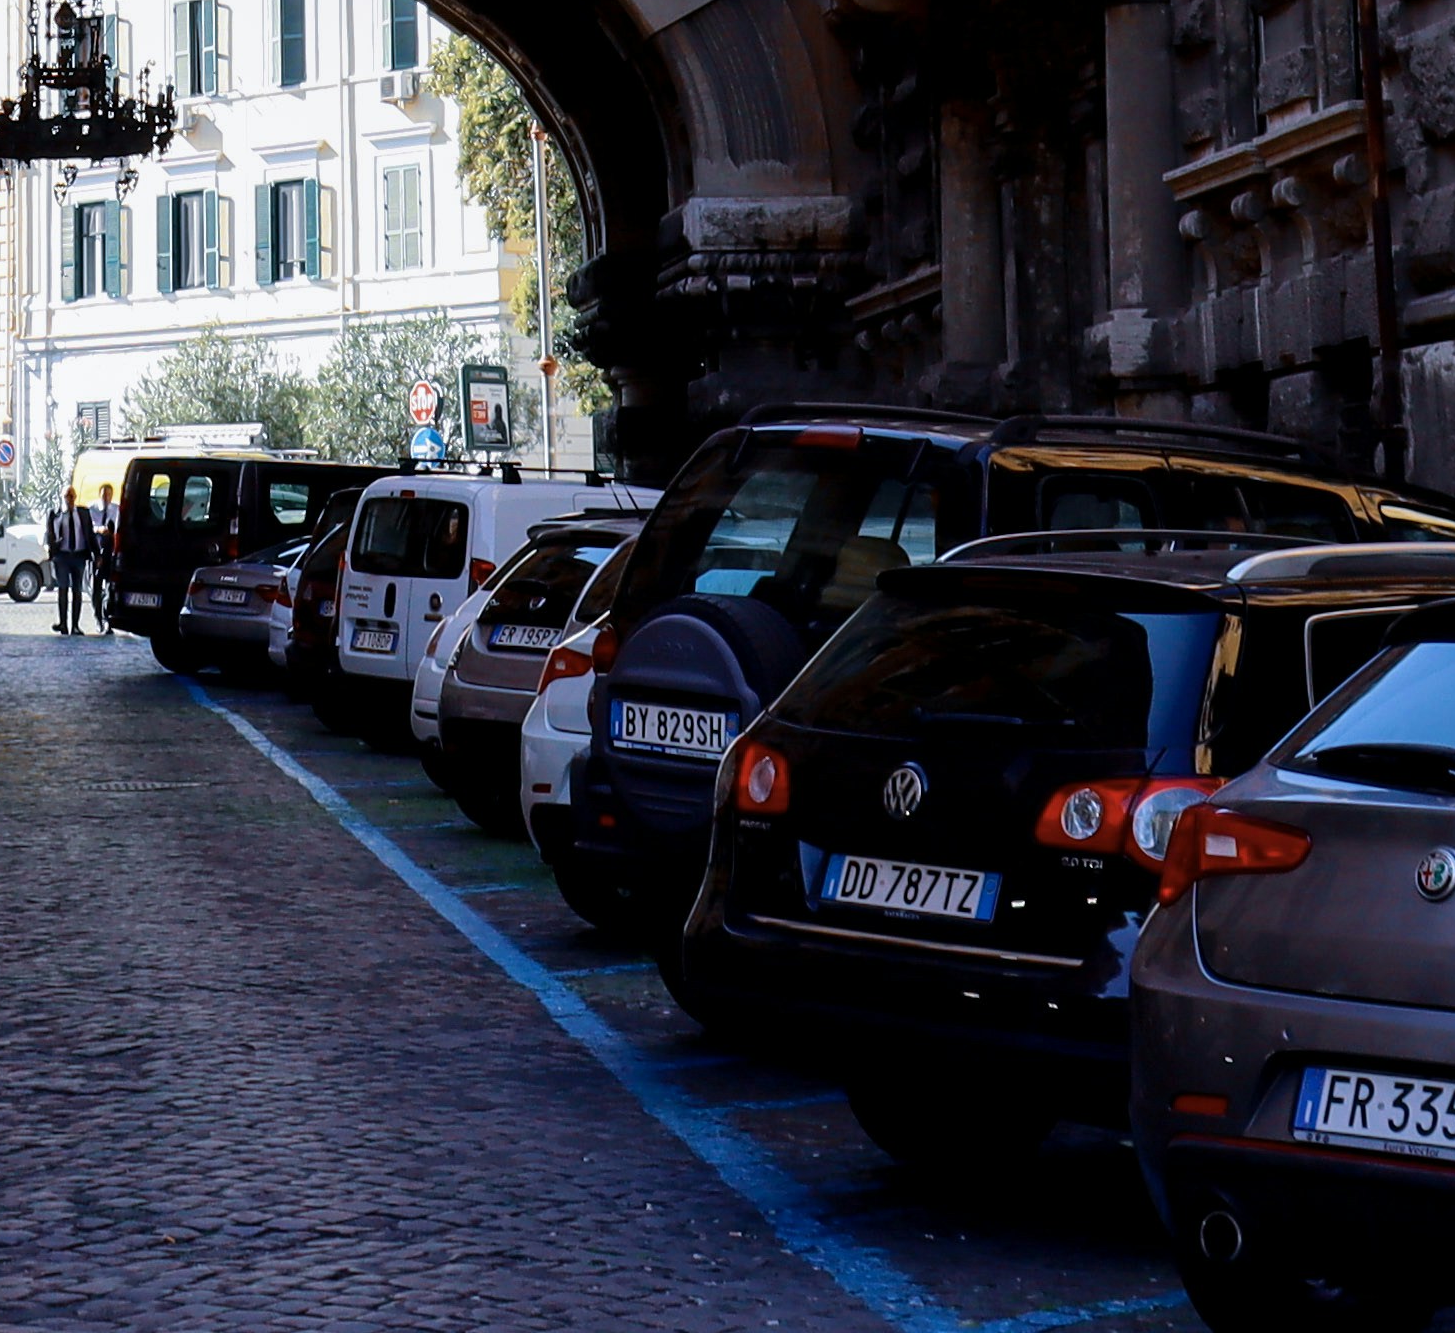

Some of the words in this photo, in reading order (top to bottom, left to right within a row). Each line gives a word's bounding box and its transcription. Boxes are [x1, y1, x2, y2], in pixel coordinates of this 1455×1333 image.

[411, 394, 433, 410] STOP
[626, 705, 648, 739] BY
[657, 710, 722, 748] 829SH
[841, 859, 878, 900] DD
[884, 865, 981, 915] 787TZ
[1322, 1075, 1375, 1129] FR
